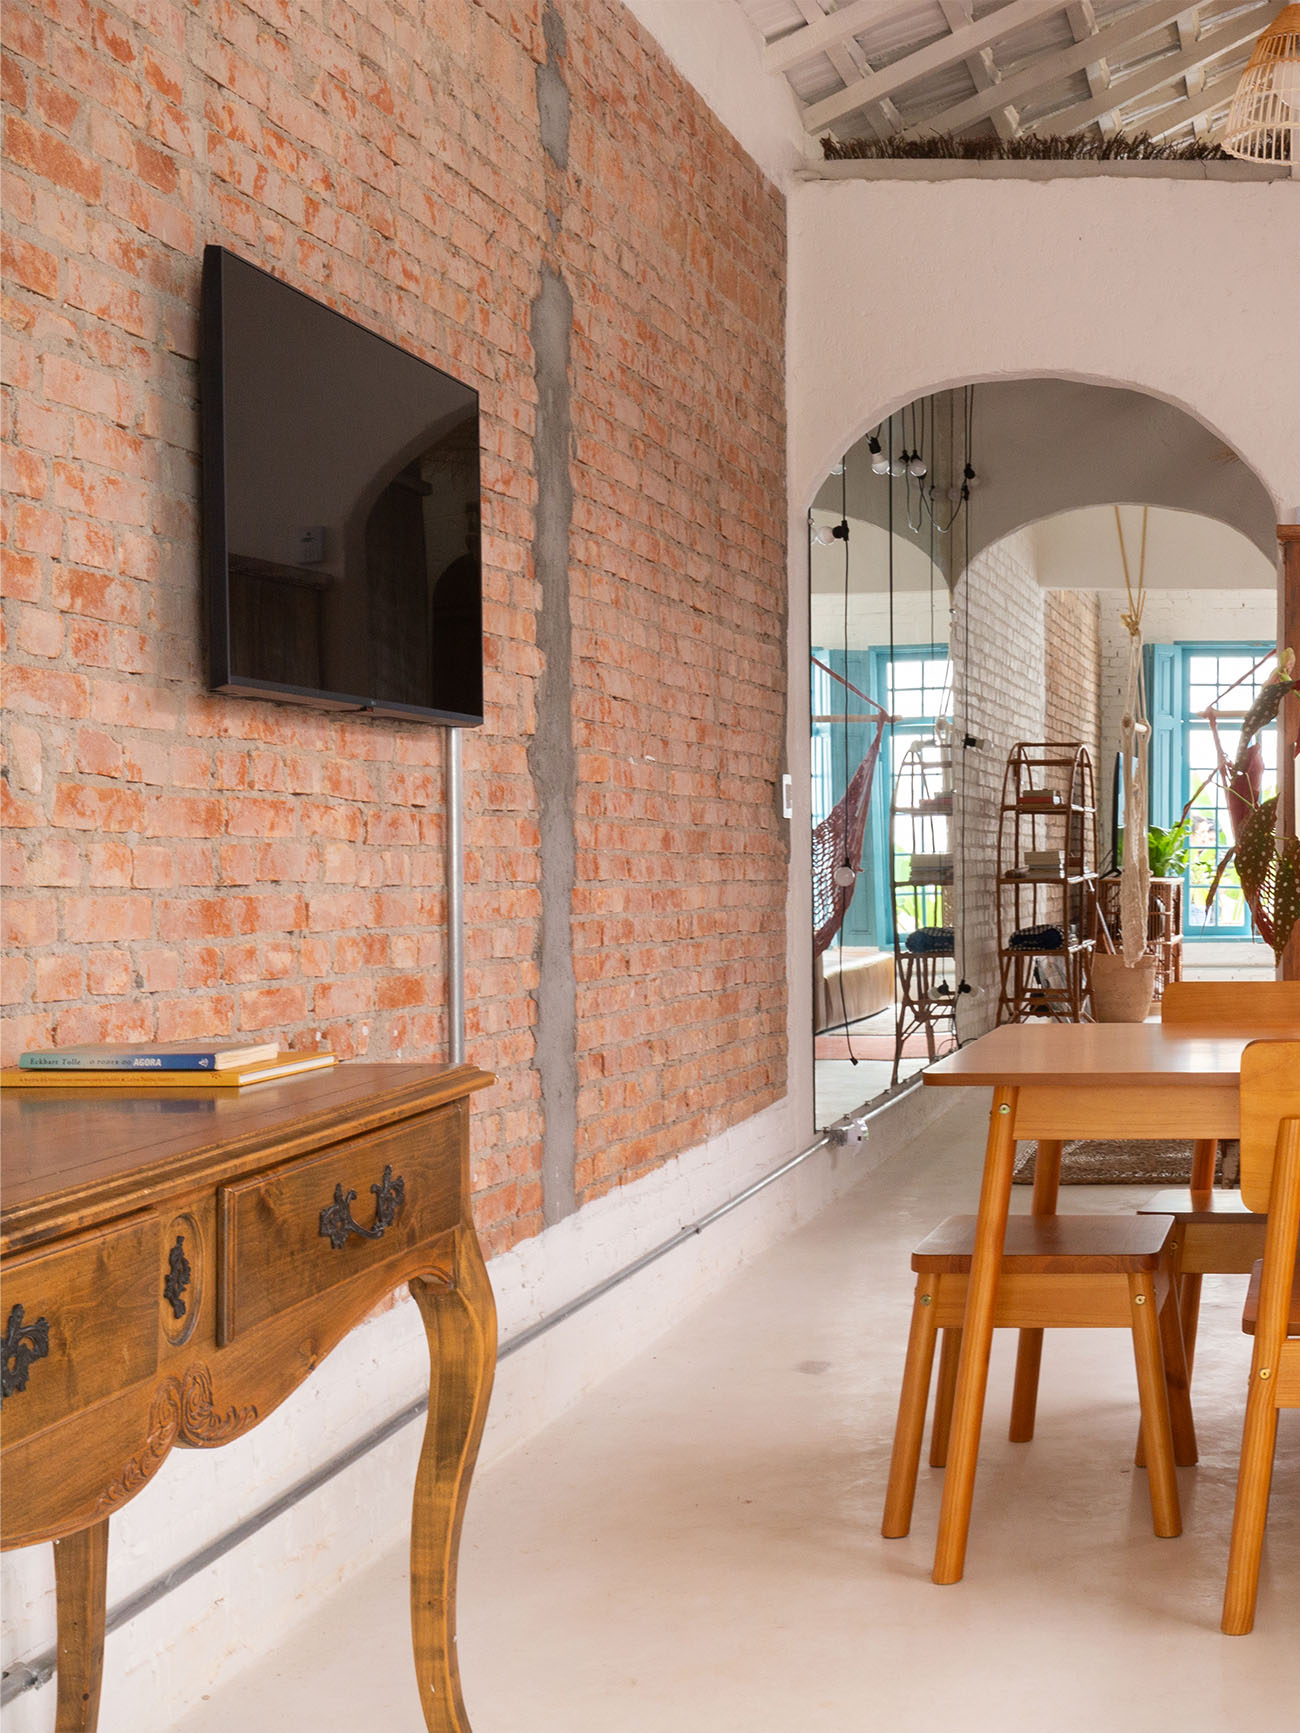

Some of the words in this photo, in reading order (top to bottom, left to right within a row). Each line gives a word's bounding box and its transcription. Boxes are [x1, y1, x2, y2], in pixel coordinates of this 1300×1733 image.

[29, 1057, 59, 1065] Eckhart
[62, 1058, 81, 1066] Tolle
[133, 1058, 162, 1067] AGORA
